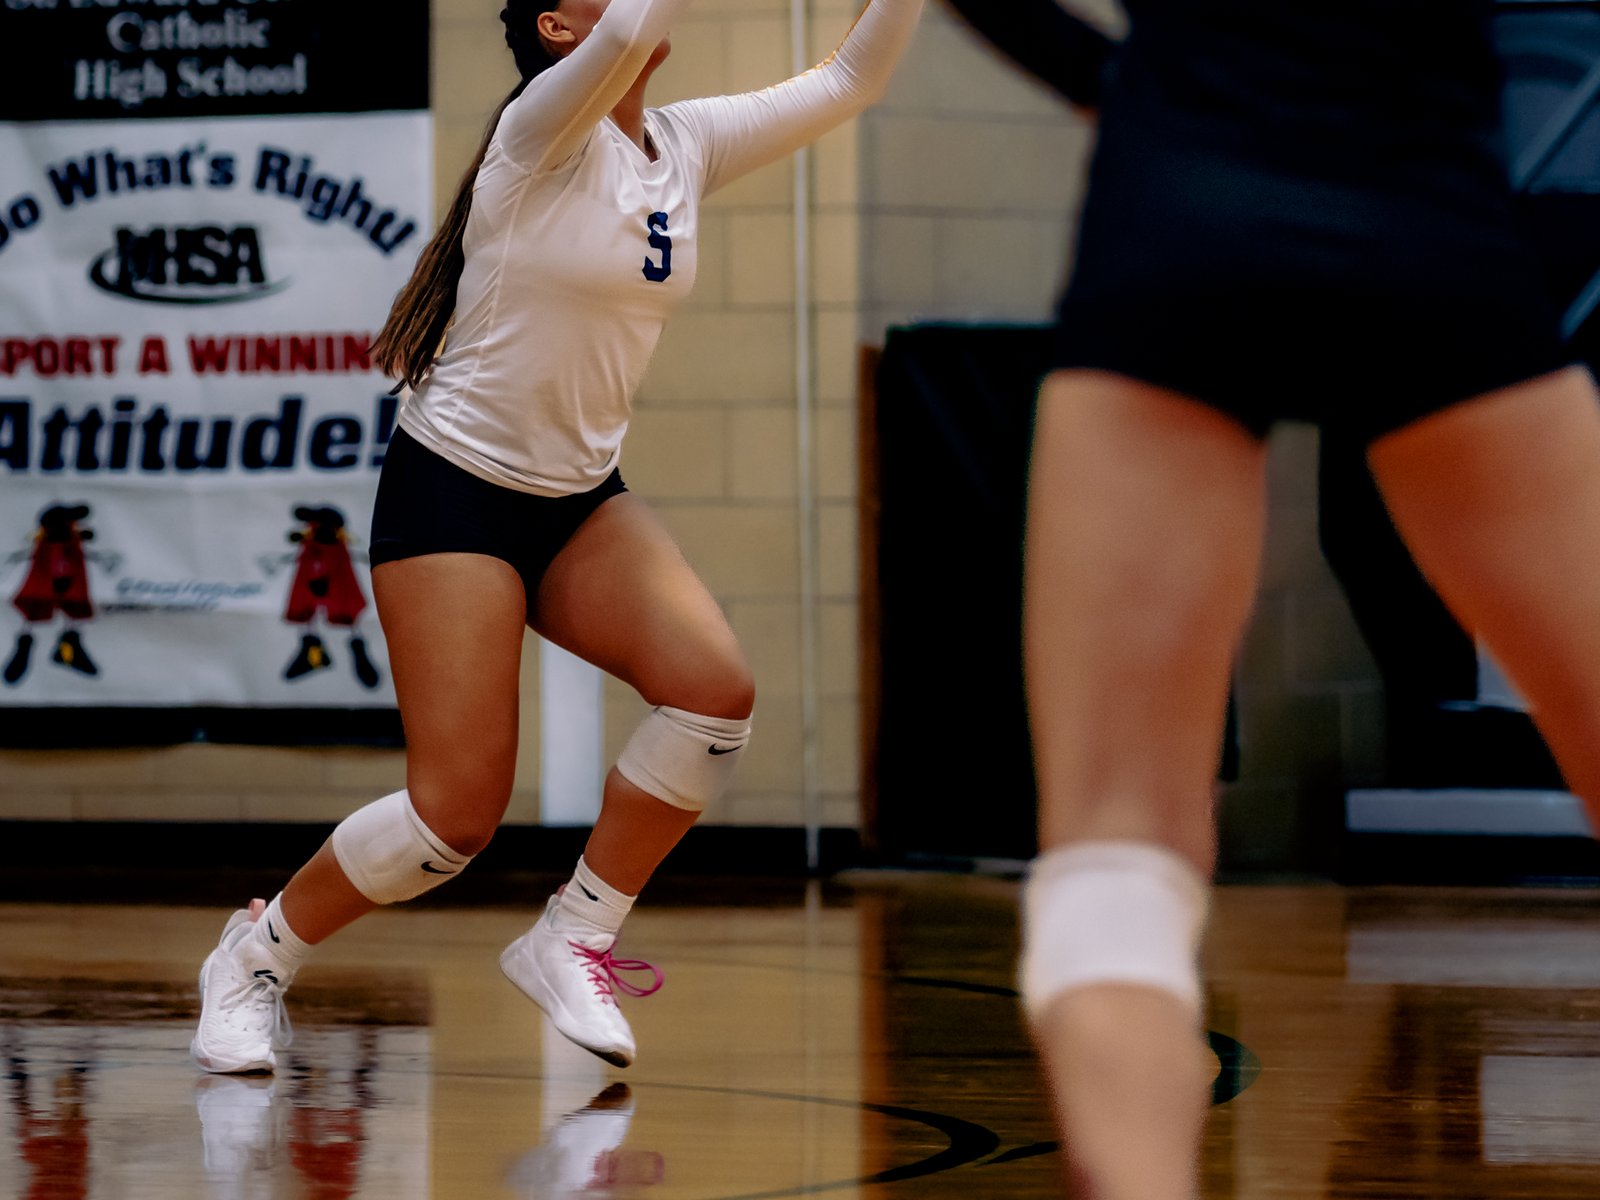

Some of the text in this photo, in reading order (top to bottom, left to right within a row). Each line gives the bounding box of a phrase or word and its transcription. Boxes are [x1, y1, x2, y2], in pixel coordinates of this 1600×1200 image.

[106, 8, 271, 53] Catholic
[73, 52, 307, 109] High School
[47, 140, 236, 208] What's
[138, 335, 169, 375] A
[187, 333, 374, 374] WINNIN
